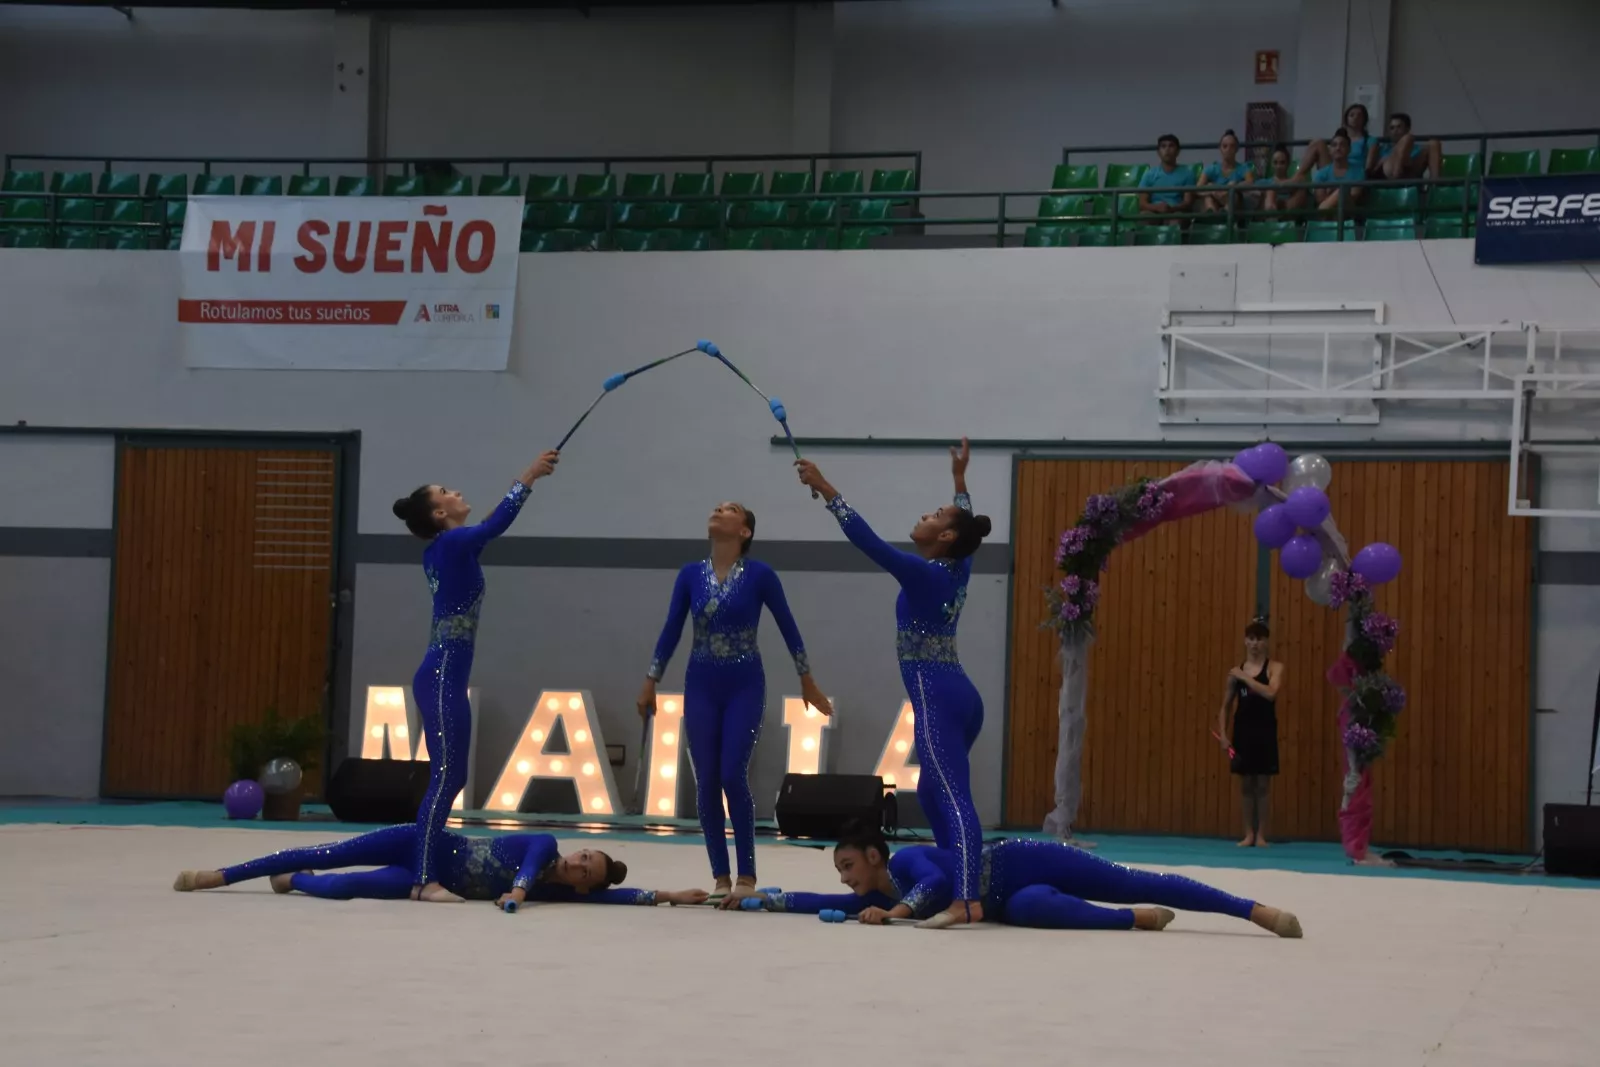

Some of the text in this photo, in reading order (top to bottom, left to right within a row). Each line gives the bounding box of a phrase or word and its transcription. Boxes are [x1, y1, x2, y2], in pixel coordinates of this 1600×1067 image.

[207, 204, 496, 274] MI SUEÑO
[200, 302, 371, 321] Rotulamos tus sueños
[434, 304, 460, 313] LETRA
